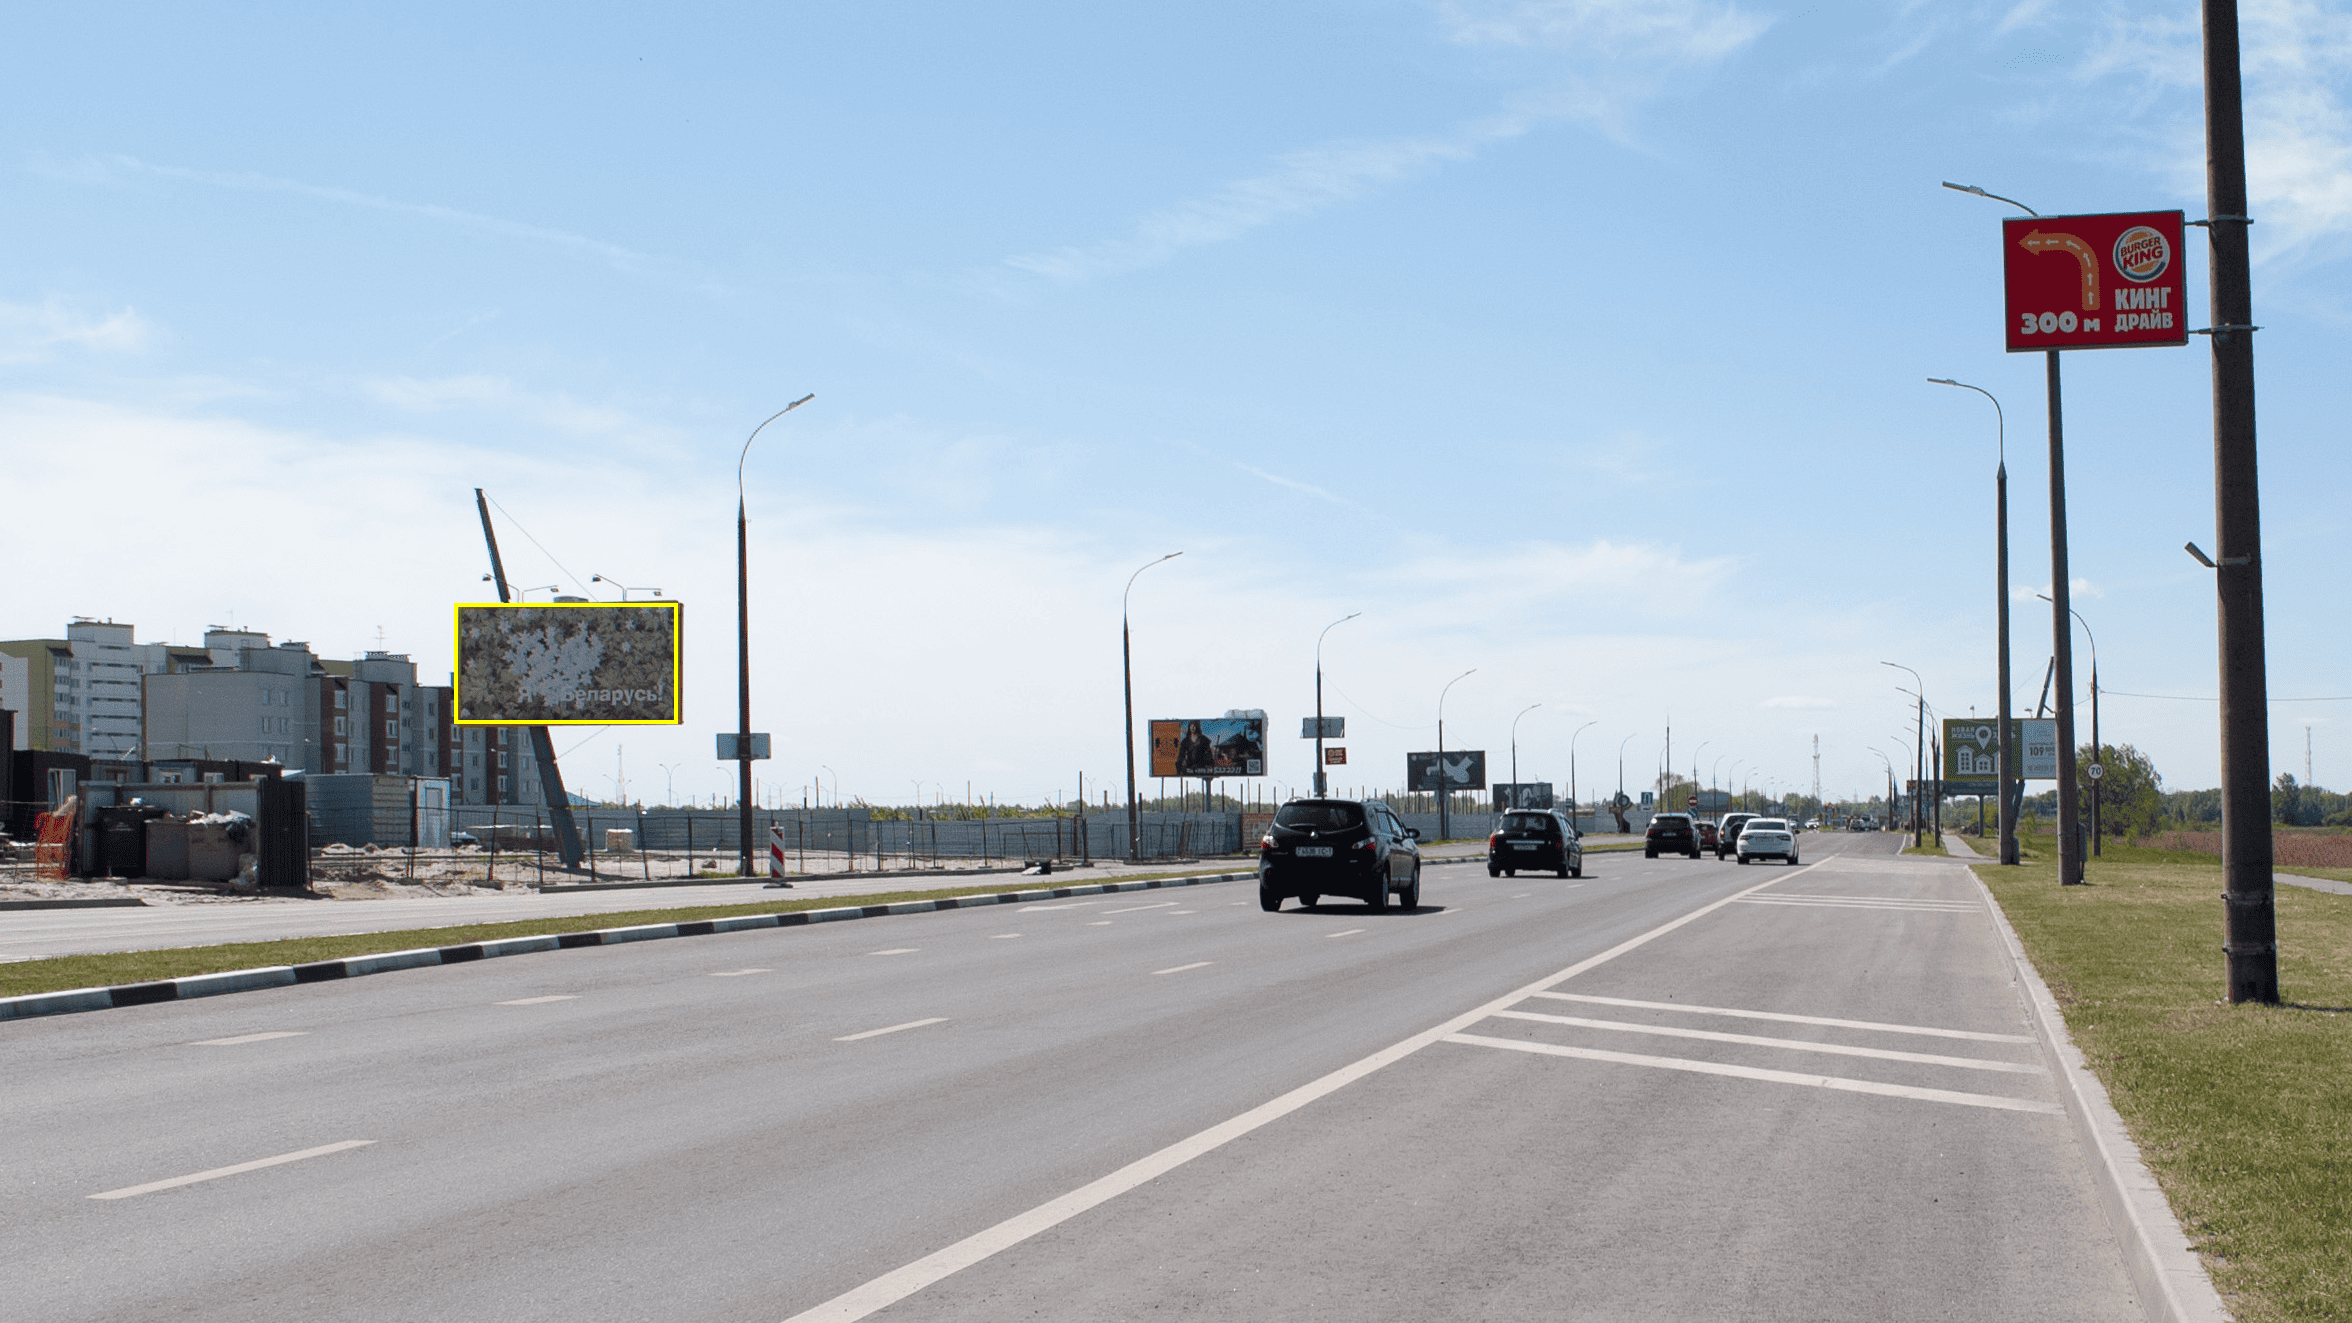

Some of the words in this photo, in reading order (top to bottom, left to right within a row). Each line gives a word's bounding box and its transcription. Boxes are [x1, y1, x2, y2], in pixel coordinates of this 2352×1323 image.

[2120, 236, 2162, 258] BURGER
[2122, 245, 2164, 269] KING
[2114, 287, 2172, 310] КИНГ
[2021, 311, 2078, 335] 300
[2114, 308, 2174, 333] ДРАЙВ
[2090, 767, 2102, 776] 70
